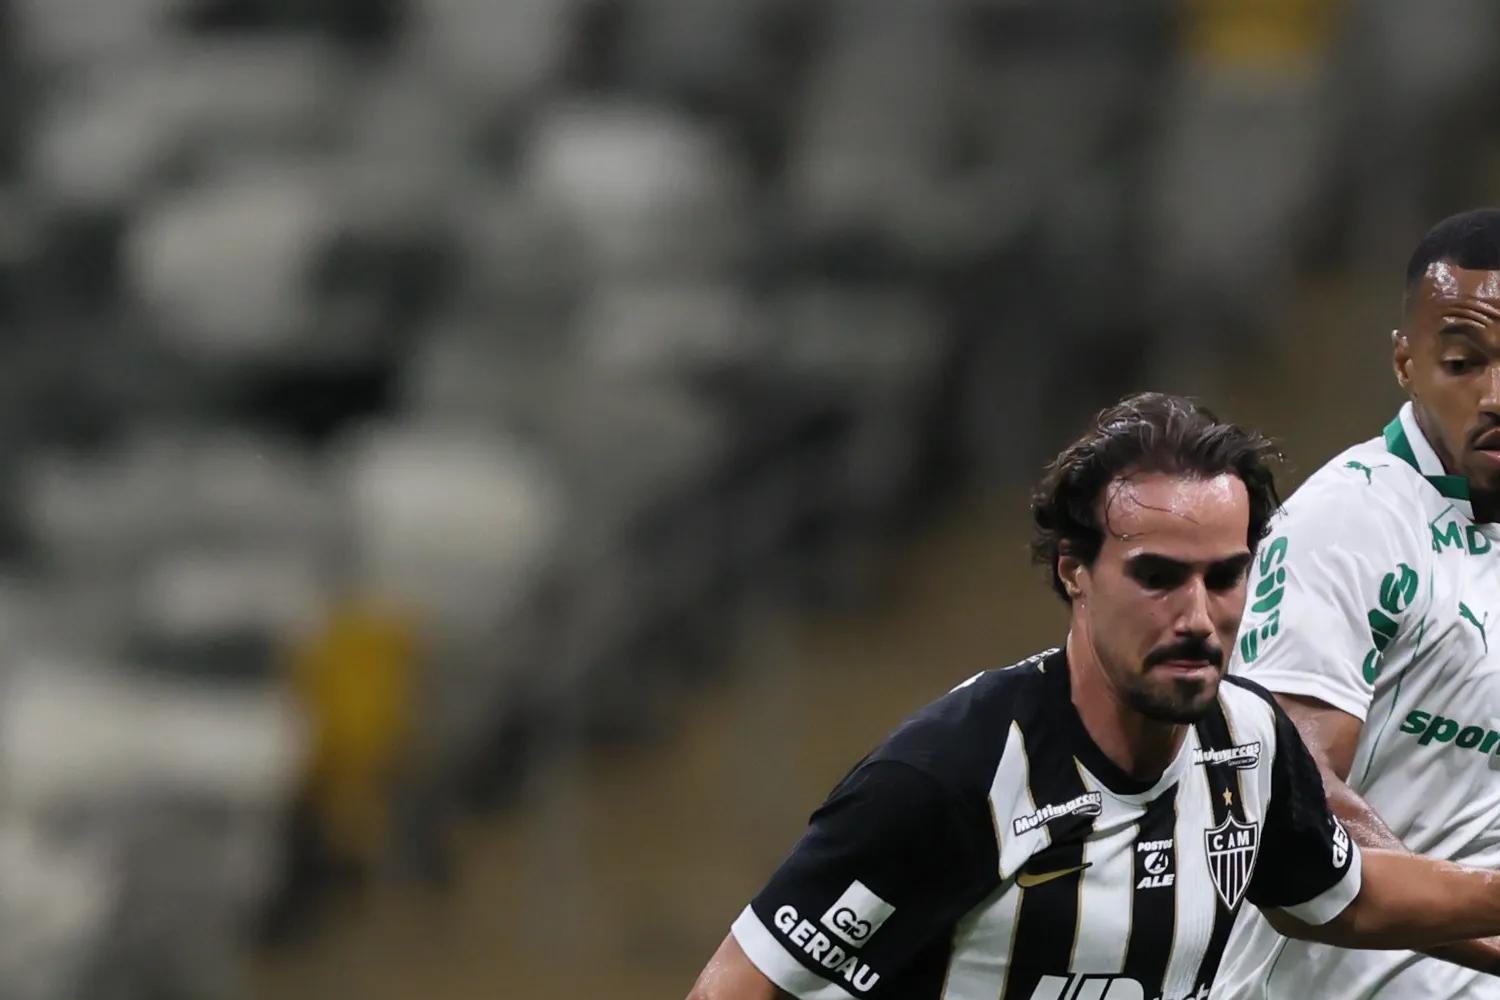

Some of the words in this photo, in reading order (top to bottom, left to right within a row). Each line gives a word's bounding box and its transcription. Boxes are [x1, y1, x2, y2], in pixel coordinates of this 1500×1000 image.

[1014, 791, 1102, 835] Multimarcas
[1212, 830, 1250, 850] CAM
[1136, 873, 1175, 890] ALE
[774, 904, 880, 992] GERDAU
